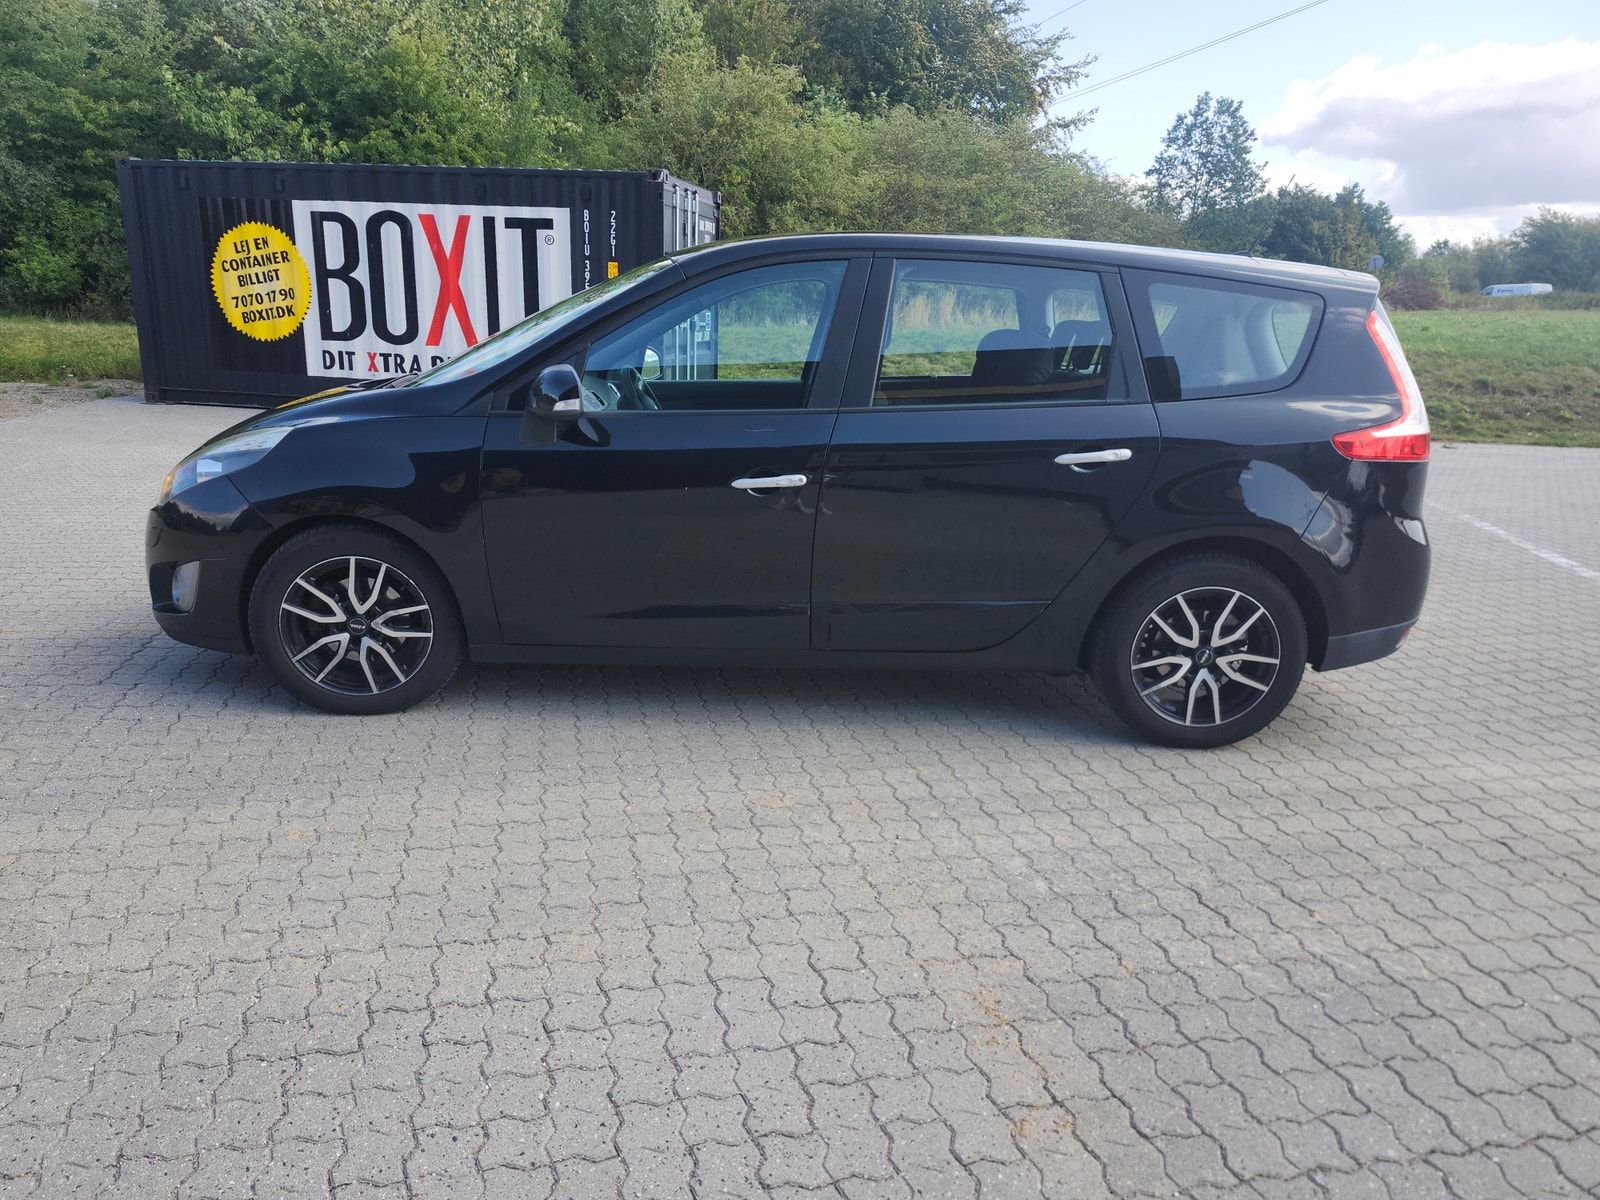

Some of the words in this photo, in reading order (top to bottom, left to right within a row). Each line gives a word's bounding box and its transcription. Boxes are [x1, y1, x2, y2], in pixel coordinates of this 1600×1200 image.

[233, 239, 251, 255] LEJ
[253, 236, 269, 250] EN
[221, 250, 290, 272] CONTAINER
[237, 268, 280, 287] BILLIGT
[310, 209, 554, 348] BOXIT
[231, 292, 264, 308] 7070
[265, 290, 276, 302] 17
[279, 287, 295, 301] 90
[241, 304, 295, 324] BOXIT.DK
[322, 350, 356, 370] DIT
[367, 351, 422, 374] XTRA
